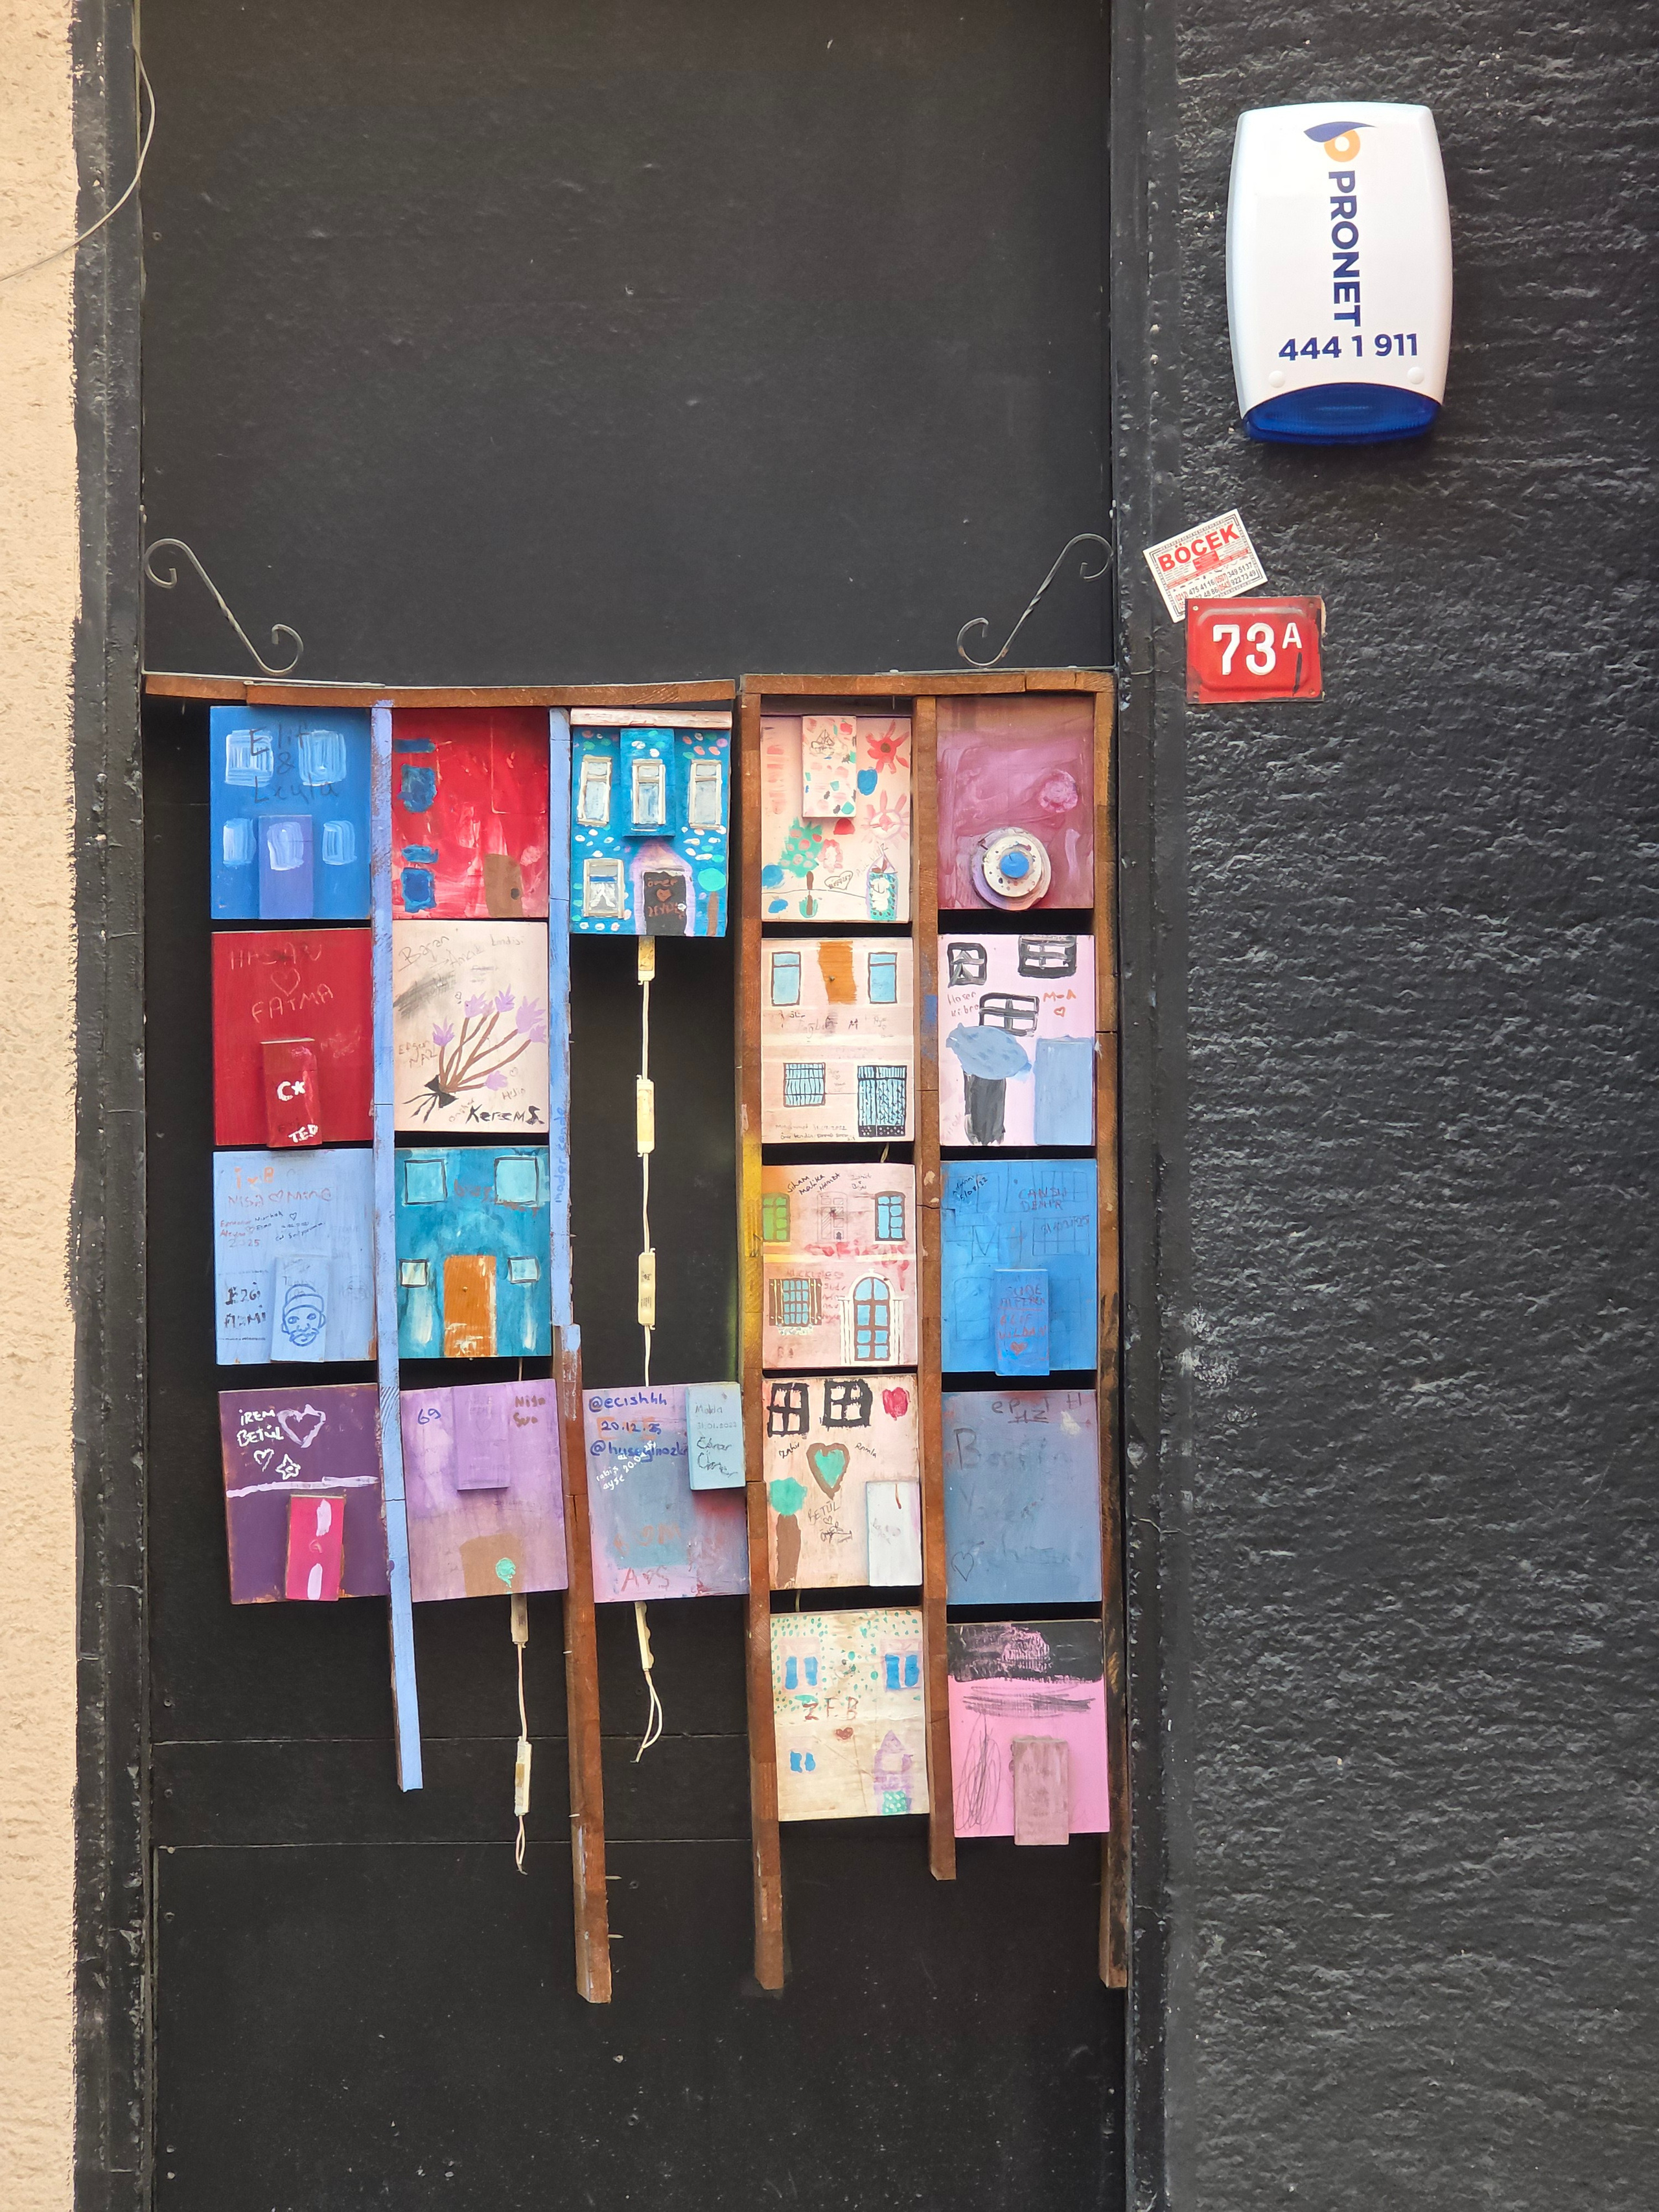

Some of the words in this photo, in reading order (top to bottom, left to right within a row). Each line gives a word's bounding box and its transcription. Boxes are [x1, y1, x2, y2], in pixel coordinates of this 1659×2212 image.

[1328, 170, 1361, 327] PRONET
[1278, 335, 1343, 362] 444
[1351, 335, 1363, 357] 1
[1374, 333, 1418, 357] 911
[1157, 523, 1240, 572] BÖCEK
